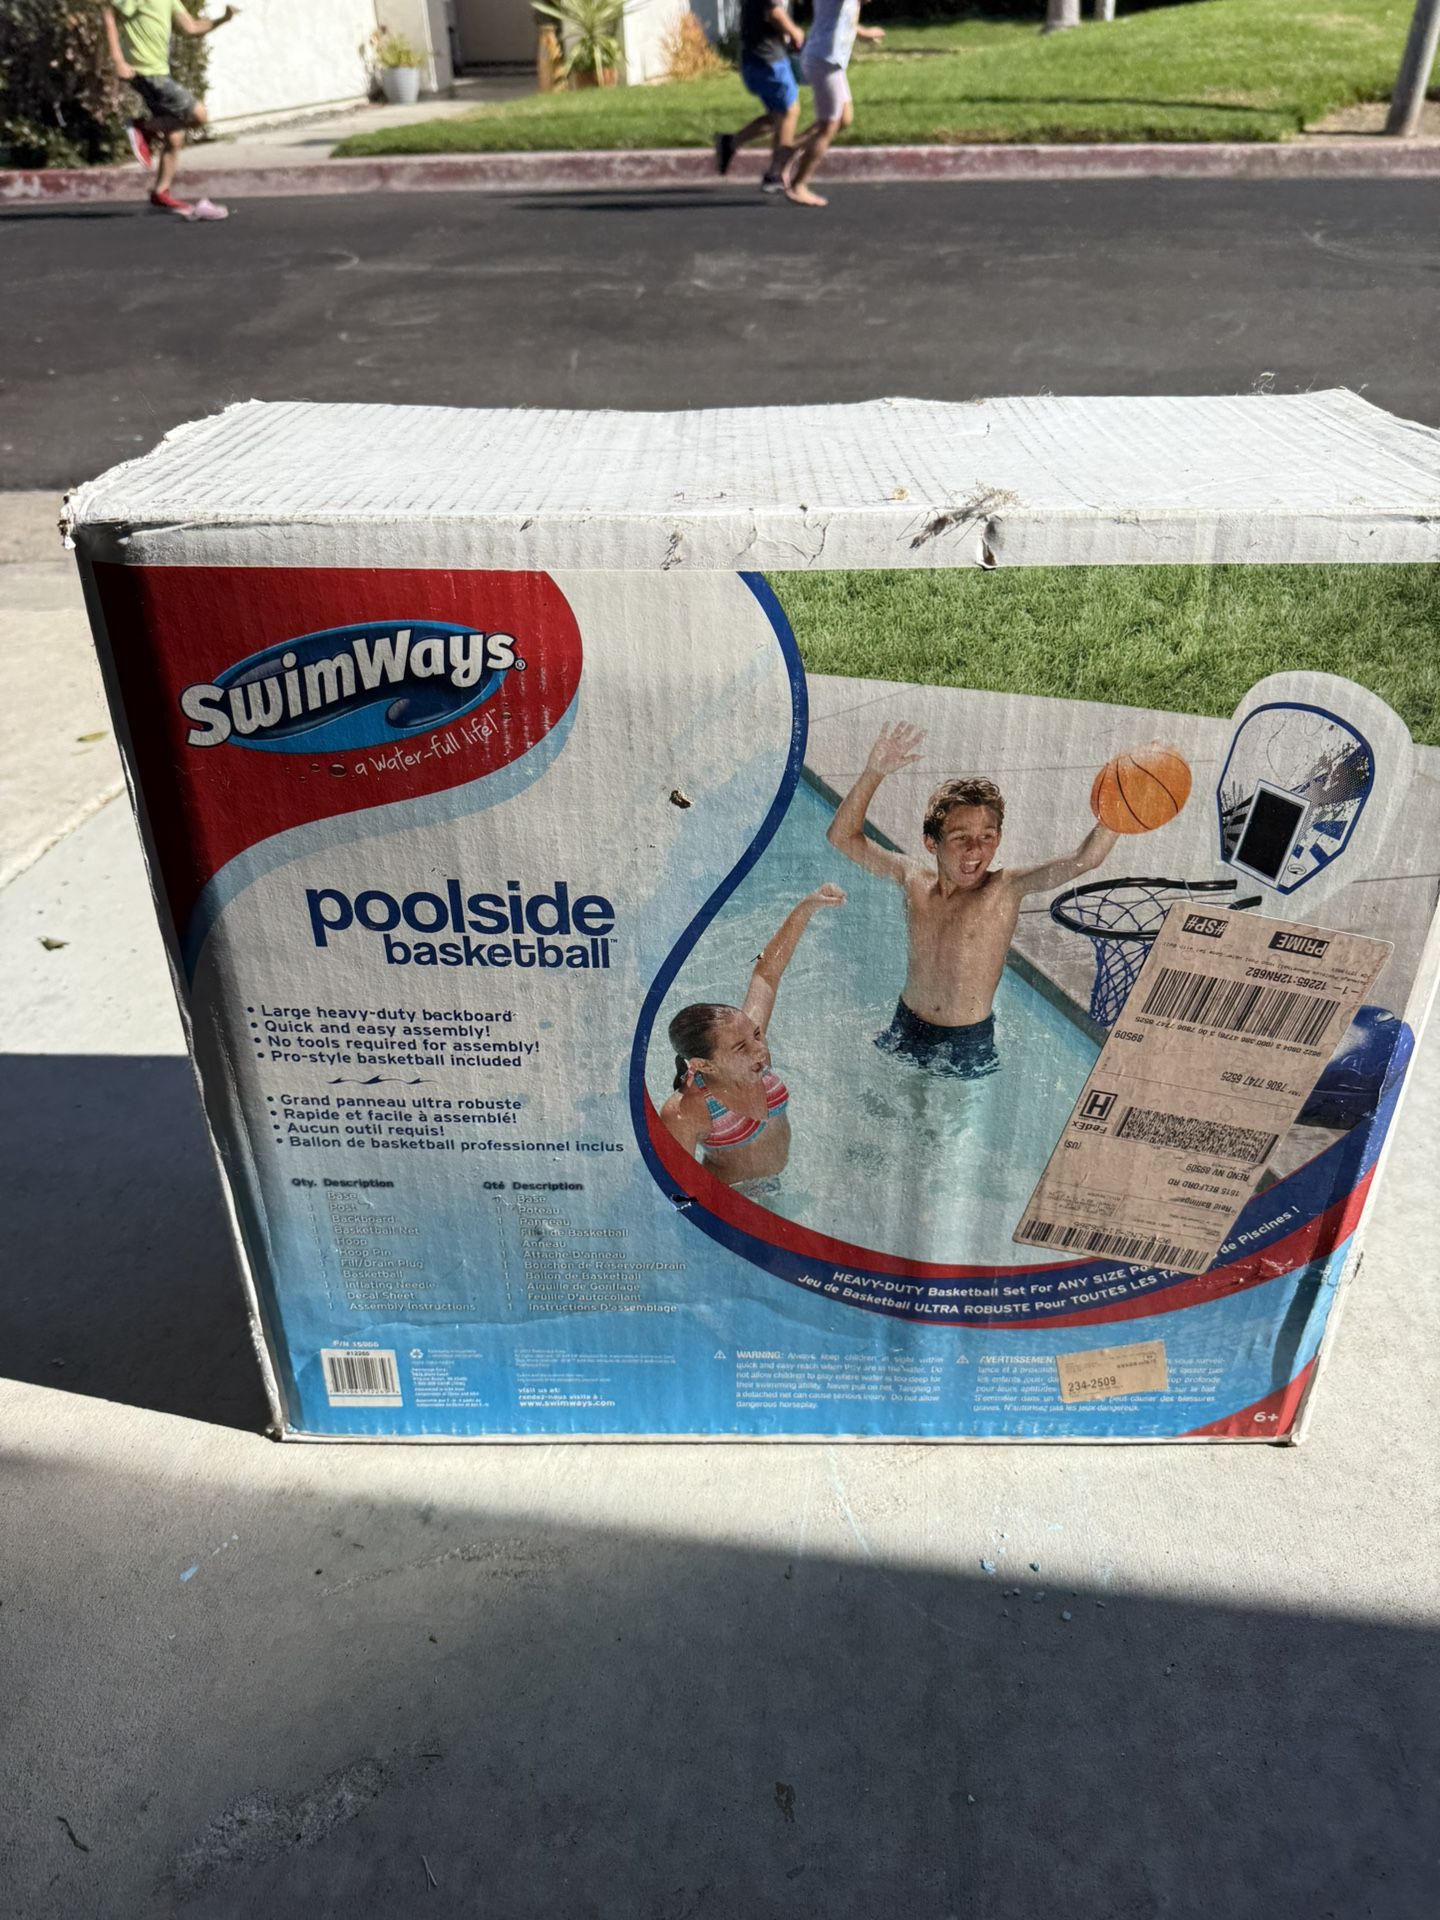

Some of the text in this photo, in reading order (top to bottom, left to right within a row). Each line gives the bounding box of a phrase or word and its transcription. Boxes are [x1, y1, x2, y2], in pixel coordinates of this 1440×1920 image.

[181, 629, 516, 747] SwimWays
[356, 762, 369, 775] a
[305, 879, 615, 947] poolside
[1186, 915, 1228, 937] #SP#
[1276, 932, 1327, 956] PRIME
[383, 934, 611, 969] basketball
[261, 1004, 513, 1024] Large heavy-duty backboard
[264, 1020, 490, 1040] Quick and easy assembly!
[1113, 1030, 1144, 1043] 89509
[268, 1036, 540, 1056] No tools required for assembly!
[270, 1050, 522, 1068] Pro-style basketball included
[1220, 1070, 1242, 1084] 6525
[1242, 1074, 1264, 1088] 7747
[1265, 1079, 1288, 1093] 7806
[280, 1094, 523, 1110] Grand panneau ultra robuste
[1087, 1093, 1112, 1117] H
[284, 1108, 518, 1124] Rapide et facile à assemblé!
[287, 1122, 446, 1138] Aucun outil requis!
[1072, 1120, 1108, 1135] FedEx
[290, 1136, 625, 1153] Ballon de basketball professionnel inclus
[1212, 1167, 1226, 1178] NV
[1228, 1170, 1250, 1182] RENO
[291, 1177, 396, 1190] Qty. Description
[512, 1181, 585, 1192] Description
[1182, 1180, 1220, 1194] BELFORD
[517, 1195, 546, 1203] Base
[330, 1203, 357, 1211] Post
[519, 1206, 559, 1214] Poteau
[333, 1214, 395, 1223] Backboard
[335, 1226, 419, 1235] Basketball Net
[551, 1229, 563, 1237] de
[569, 1229, 629, 1237] Basketball
[1220, 1243, 1236, 1256] de
[1237, 1213, 1293, 1246] Piscines
[337, 1238, 368, 1246] Hoop
[340, 1248, 391, 1257] Hoop Pin
[523, 1250, 626, 1259] Attache D'anneau
[342, 1258, 425, 1269] Fill/Drain Plug
[525, 1261, 575, 1269] Bouchon
[343, 1270, 403, 1278] Basketball
[565, 1272, 578, 1280] de
[581, 1272, 641, 1280] Basketball
[345, 1280, 437, 1289] Inflating Needle
[527, 1282, 639, 1291] Aiguille de Gonflage
[832, 1271, 925, 1294] HEAVY-DUTY
[927, 1287, 998, 1298] Basketball
[1002, 1286, 1026, 1298] Set
[1030, 1282, 1054, 1294] For
[1056, 1276, 1090, 1292] ANY
[1092, 1268, 1127, 1286] SIZE
[347, 1291, 379, 1299] Decal
[528, 1293, 641, 1301] Feuille D'autocollant
[797, 1274, 1158, 1315] Jeu de Basketball ULTRA ROBUSTE Pour TOUTES LES
[349, 1302, 477, 1311] Assembly Instructions
[530, 1303, 677, 1312] Instructions D'assemblage
[1068, 1375, 1116, 1392] 234-2509
[519, 1400, 616, 1408] www.swimways.com
[1252, 1410, 1279, 1424] 6+
